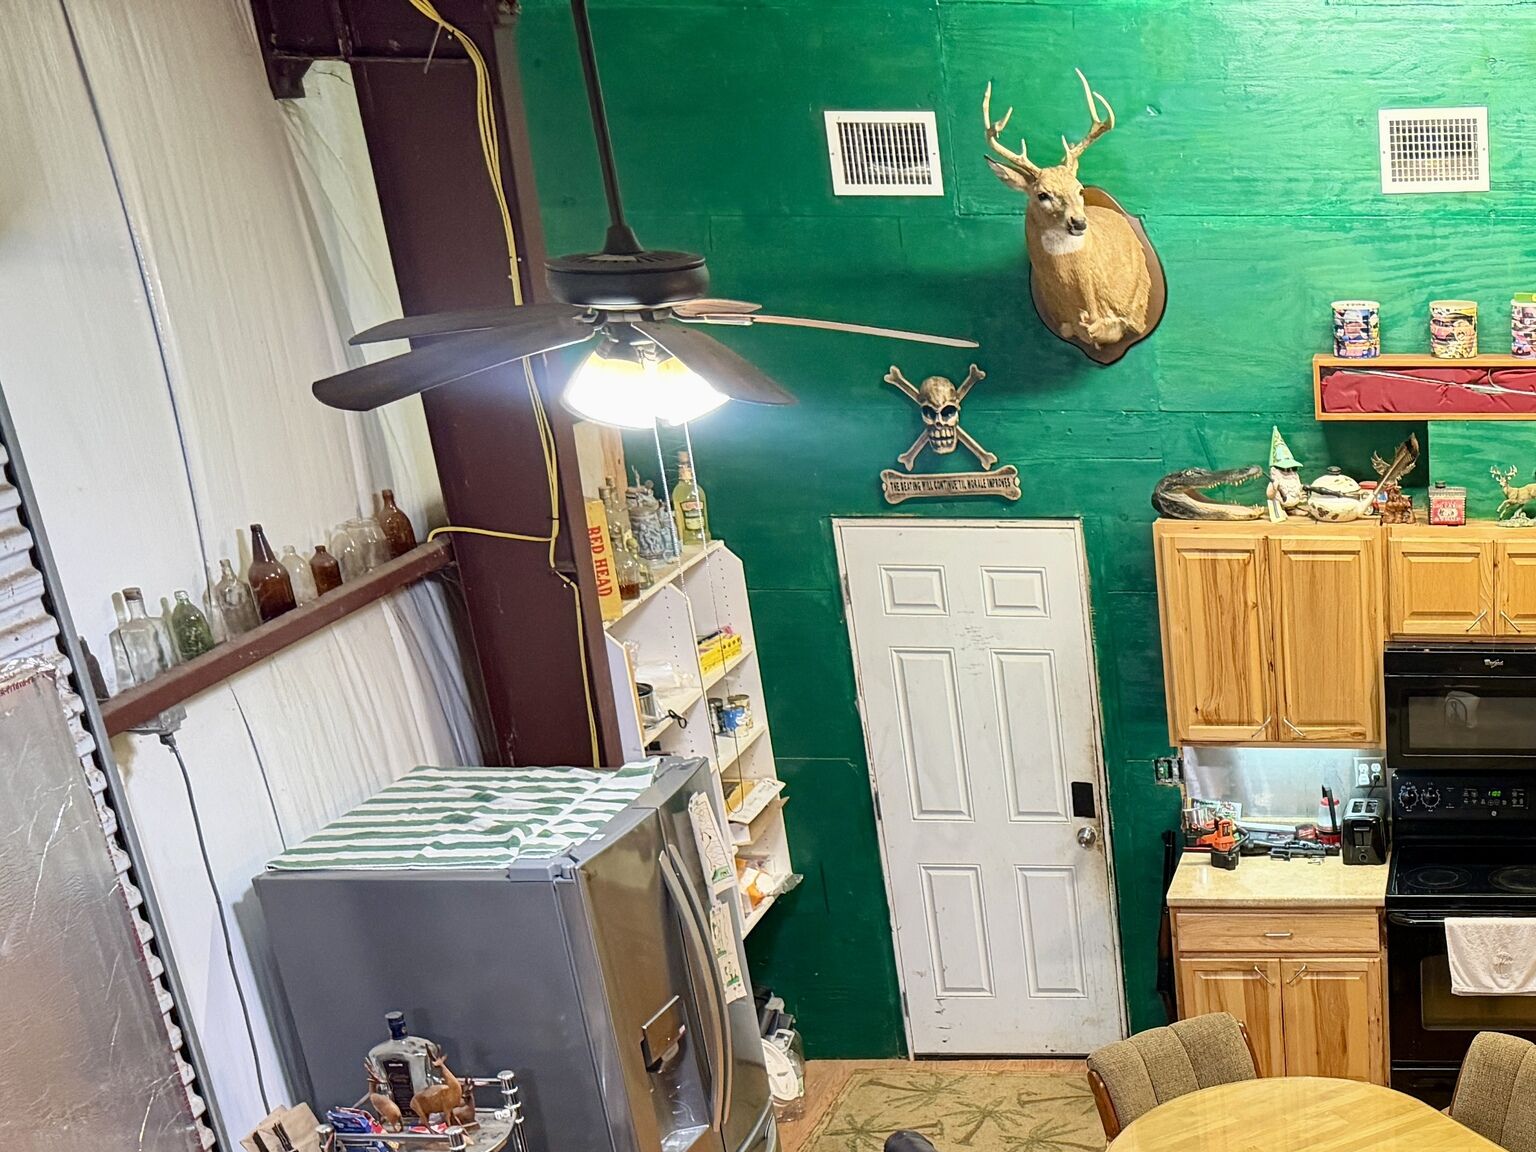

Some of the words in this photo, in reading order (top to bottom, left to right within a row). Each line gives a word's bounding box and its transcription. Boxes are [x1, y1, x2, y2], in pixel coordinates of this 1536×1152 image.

[889, 481, 901, 492] THE
[901, 480, 922, 491] BEATING
[922, 480, 934, 491] WILL
[987, 477, 1012, 489] IMPROVES
[587, 525, 606, 554] RED
[594, 558, 613, 597] HEAD
